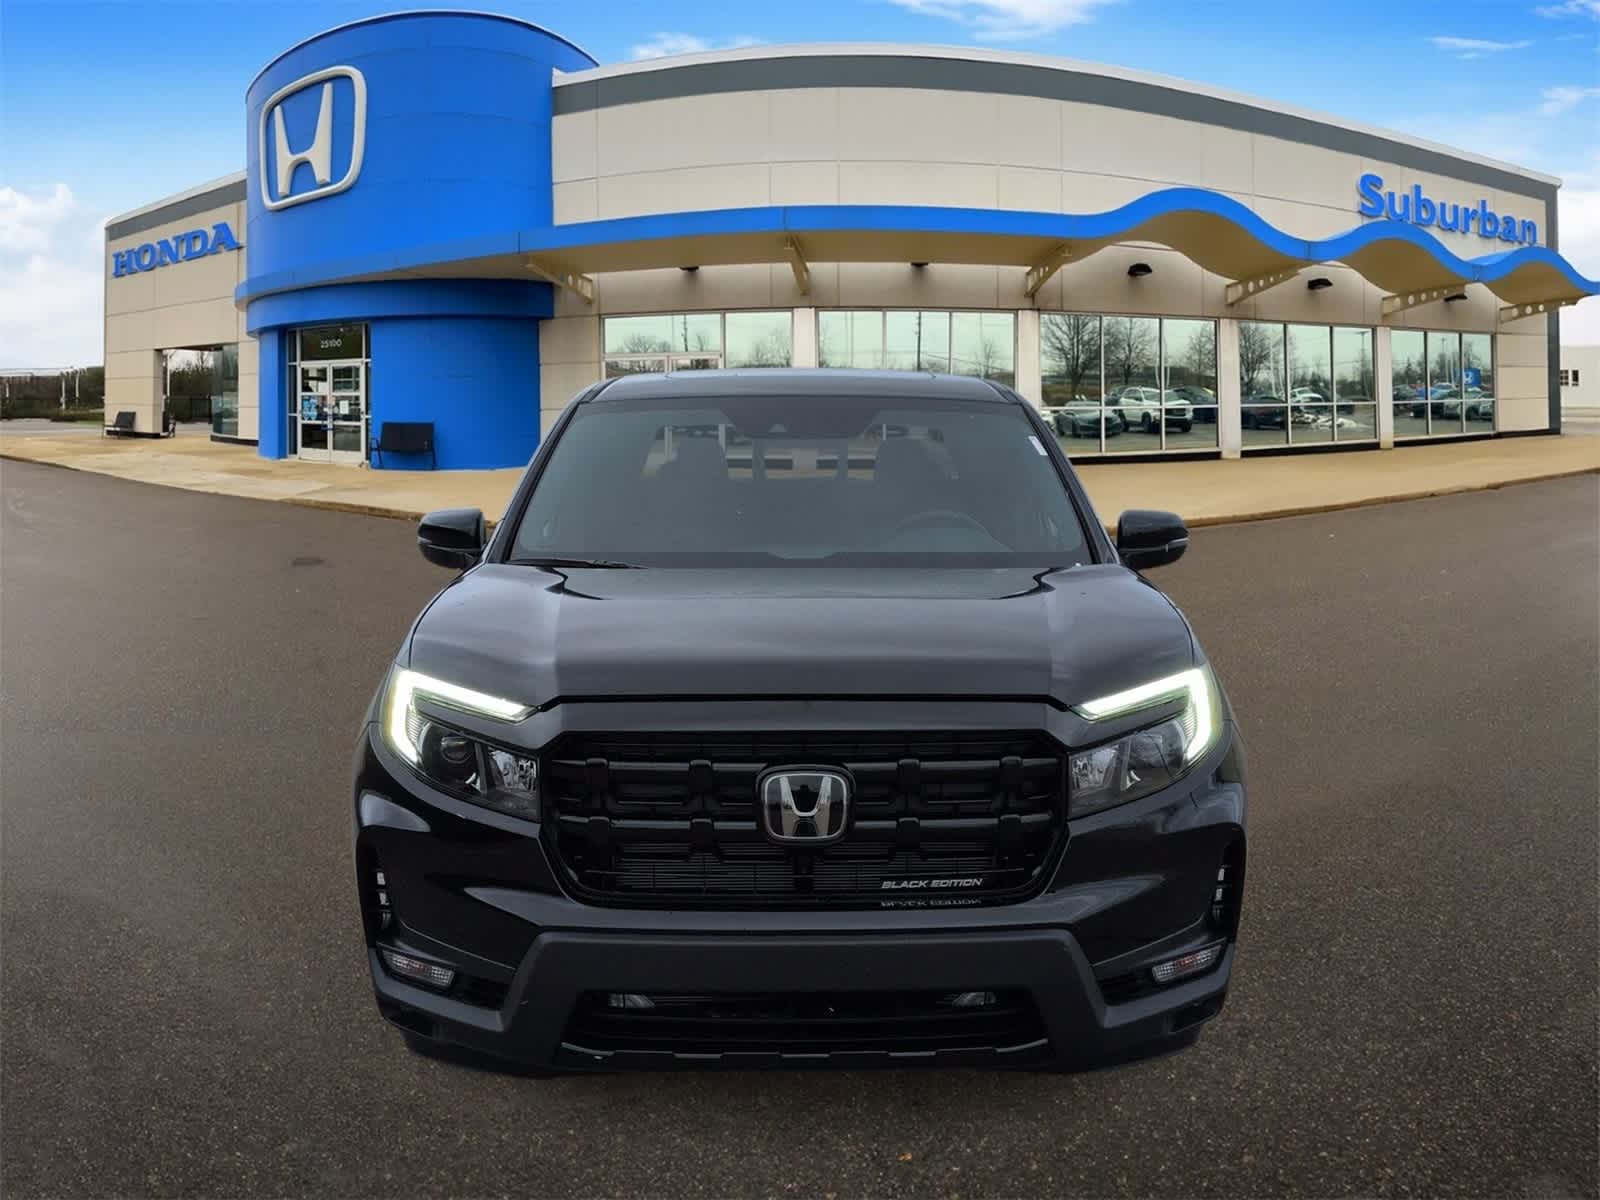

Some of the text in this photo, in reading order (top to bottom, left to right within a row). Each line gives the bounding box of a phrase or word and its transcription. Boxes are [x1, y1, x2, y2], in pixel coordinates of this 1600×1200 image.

[1358, 173, 1538, 246] Suburban
[111, 221, 242, 278] HONDA
[881, 878, 983, 889] BLACK EDITION
